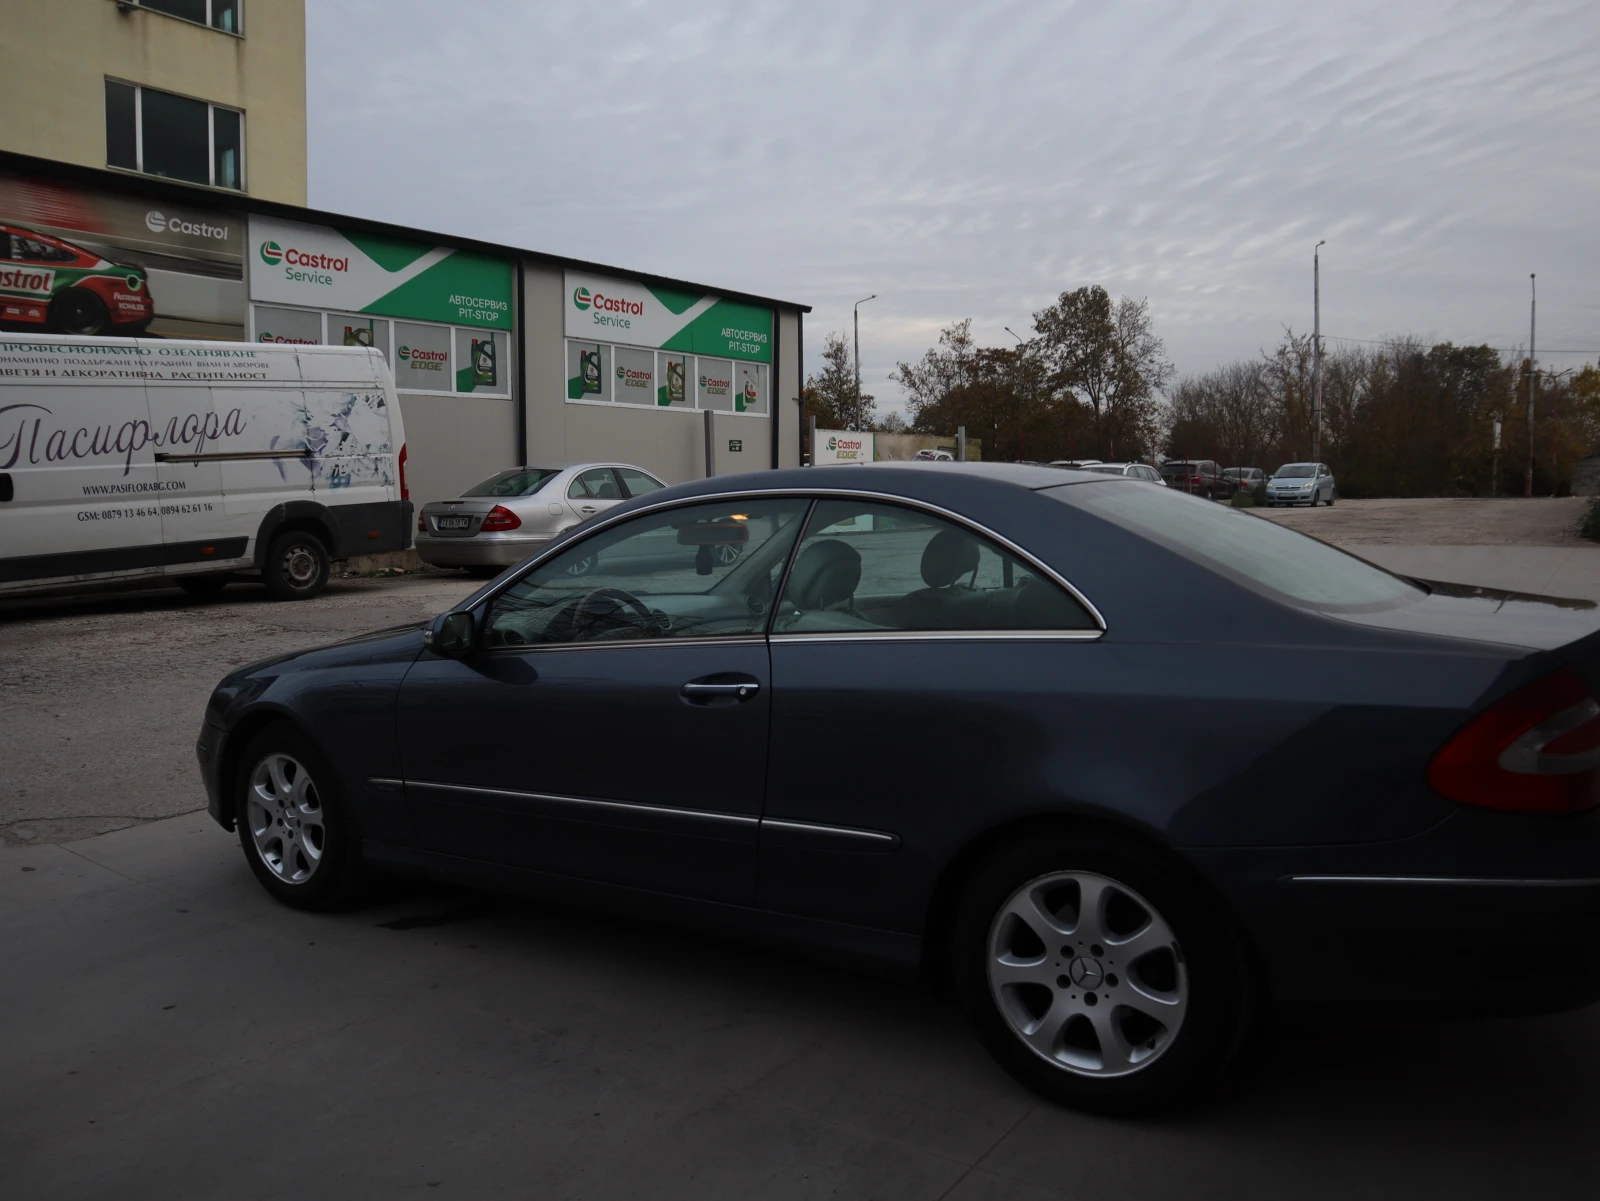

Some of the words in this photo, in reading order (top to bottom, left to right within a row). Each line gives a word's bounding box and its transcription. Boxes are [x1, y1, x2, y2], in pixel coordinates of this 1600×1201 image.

[168, 218, 228, 240] Castrol
[285, 248, 348, 273] Castrol
[285, 268, 333, 286] Service
[448, 294, 508, 311] АВТОСЕРВИЗ
[593, 294, 643, 316] Castrol
[458, 308, 498, 322] PIT-STOP
[593, 312, 631, 328] Service
[721, 328, 767, 343] АВТОСЕРВИЗ
[159, 348, 257, 358] ОЗЕЛЕНЯВАНЕ
[728, 340, 760, 354] PIT-STOP
[64, 358, 131, 366] ПОДДЪРЖАНЕ
[412, 349, 448, 362] Castrol
[410, 360, 442, 371] EDGE
[45, 369, 55, 377] И
[61, 370, 163, 378] ДЕКОРАТИВНА
[626, 370, 652, 380] Castrol
[625, 379, 648, 388] EDGE
[707, 378, 730, 388] Castrol
[706, 387, 726, 396] EDGE
[0, 404, 247, 476] Пасифлора
[838, 440, 862, 450] Castrol
[836, 451, 858, 459] EDGE
[82, 481, 186, 495] WWW.PASIFLORABG.COM
[78, 511, 100, 522] GSM:
[102, 510, 122, 520] 0879
[125, 509, 134, 518] 13
[136, 508, 146, 517] 46
[148, 507, 160, 517] 64,
[161, 506, 179, 515] 0894
[182, 504, 191, 514] 62
[192, 504, 201, 512] 61
[204, 503, 212, 511] 16
